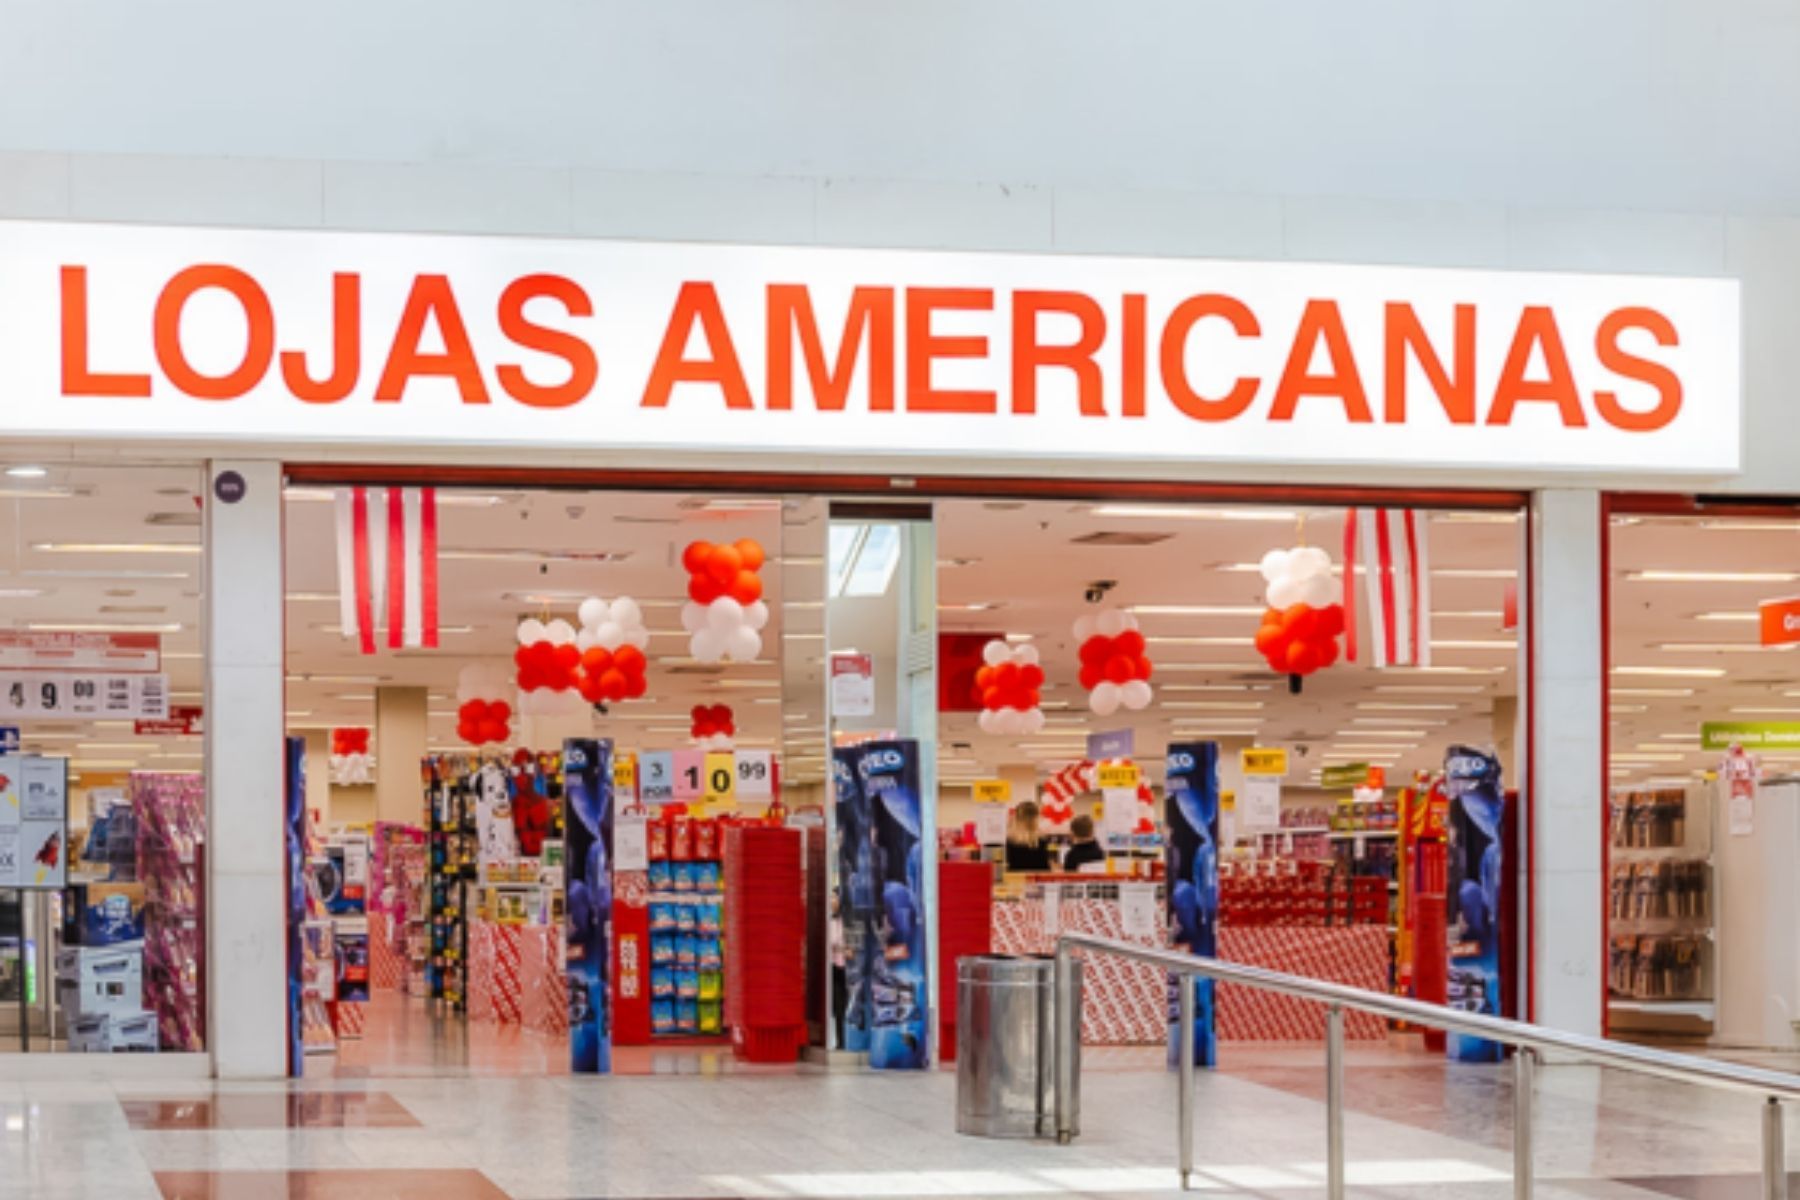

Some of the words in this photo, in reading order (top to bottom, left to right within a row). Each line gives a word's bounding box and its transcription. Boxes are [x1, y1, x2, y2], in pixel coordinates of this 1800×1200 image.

[60, 264, 599, 408] LOJAS
[640, 280, 1684, 432] AMERICANAS
[651, 762, 664, 778] 3
[738, 760, 766, 779] 99
